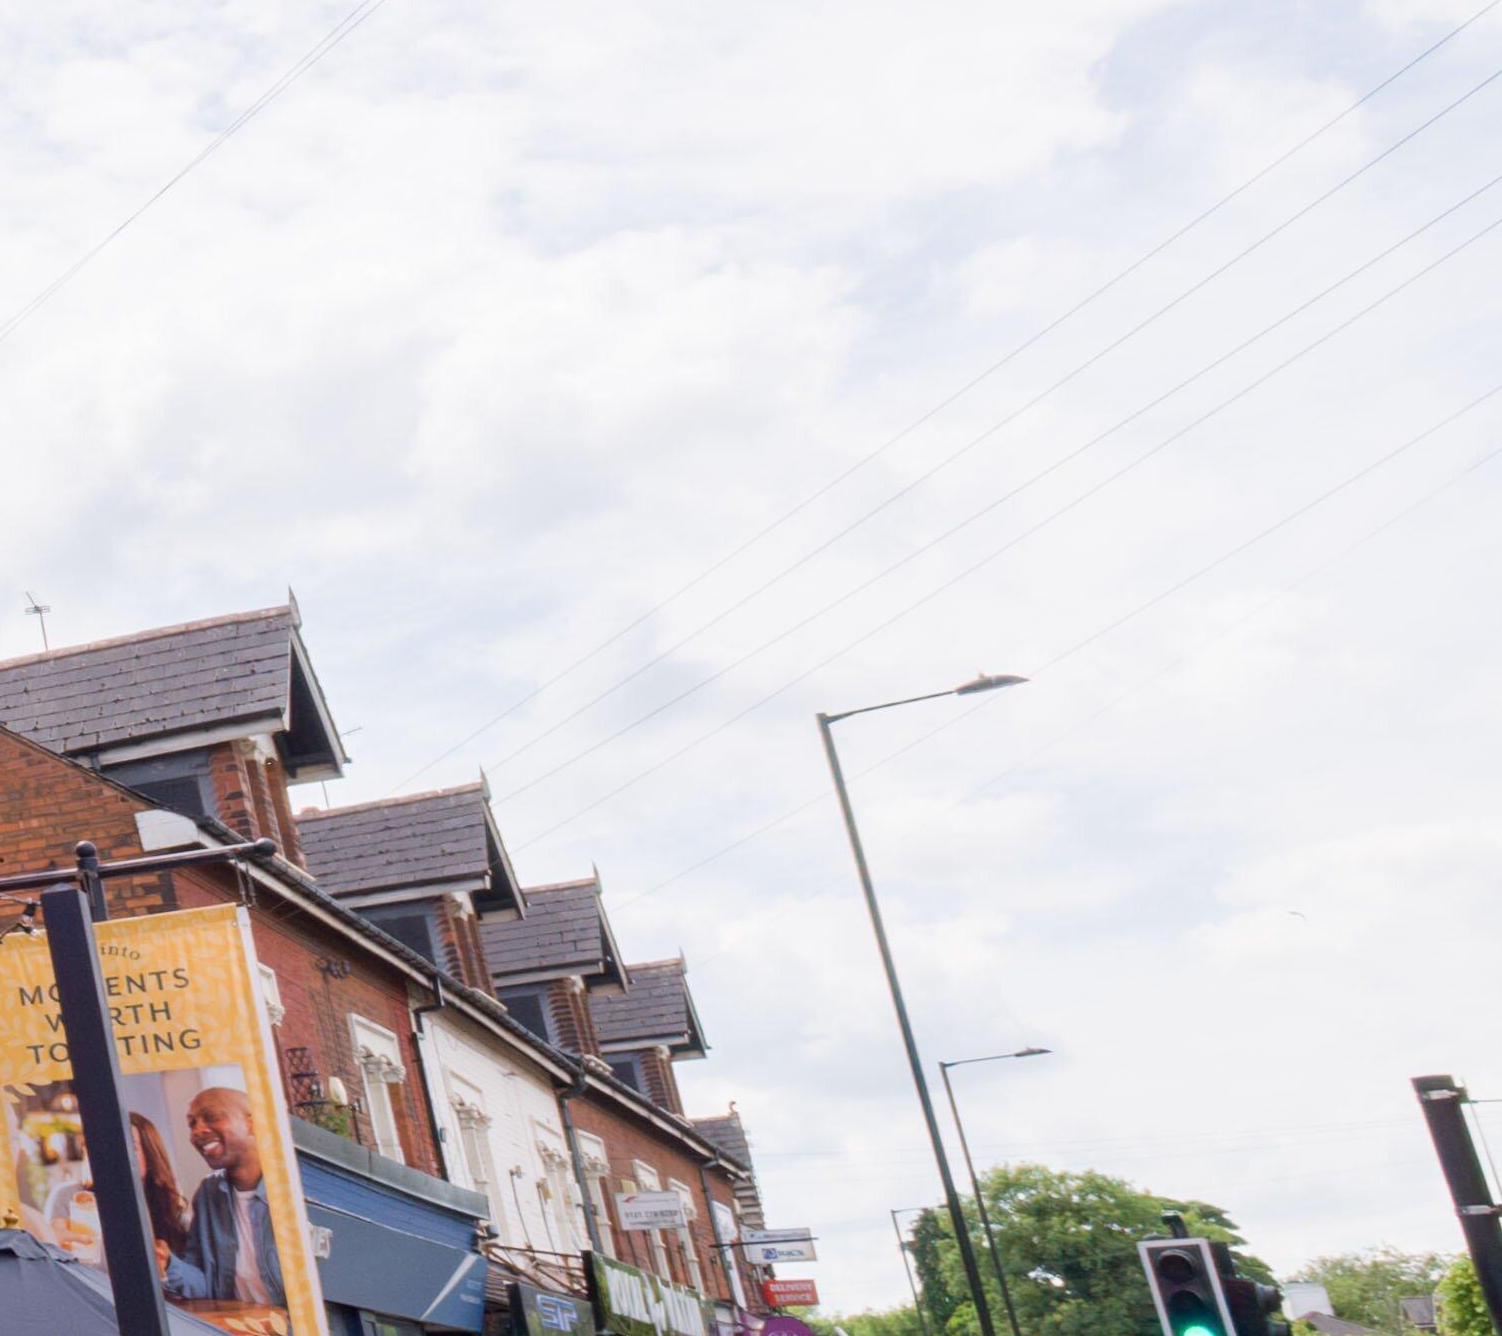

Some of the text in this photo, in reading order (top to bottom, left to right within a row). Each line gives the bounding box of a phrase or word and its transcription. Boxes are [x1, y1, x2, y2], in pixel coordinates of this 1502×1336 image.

[100, 942, 141, 961] into
[19, 968, 190, 1006] MOENTS
[45, 1001, 171, 1033] WRTH
[26, 1029, 202, 1065] TOTING
